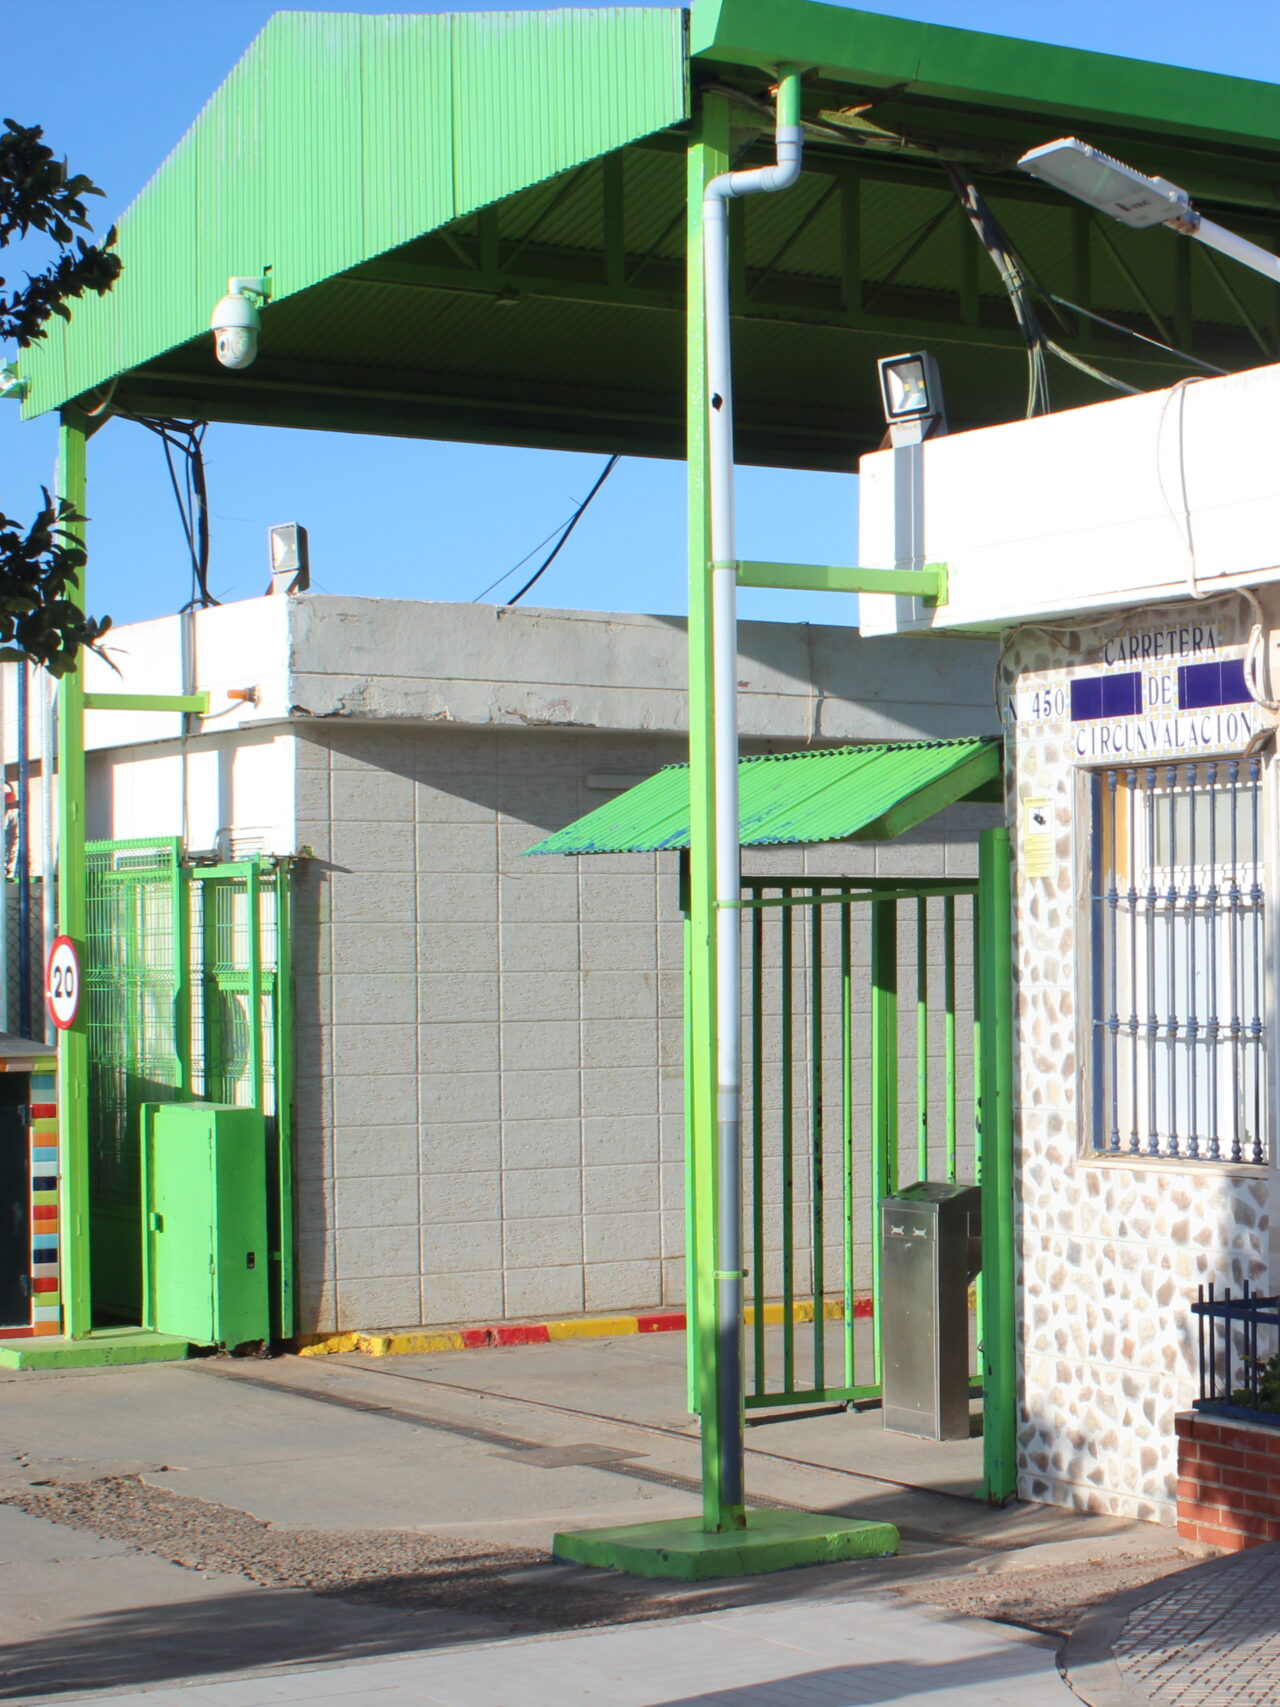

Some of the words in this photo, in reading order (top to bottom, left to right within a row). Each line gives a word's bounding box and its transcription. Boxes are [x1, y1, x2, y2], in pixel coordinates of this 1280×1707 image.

[1104, 626, 1216, 667] CARRETERA
[1032, 689, 1065, 719] 450
[1148, 676, 1172, 706] DE
[1076, 712, 1252, 756] CIRCUNVALACION
[53, 965, 74, 999] 20
